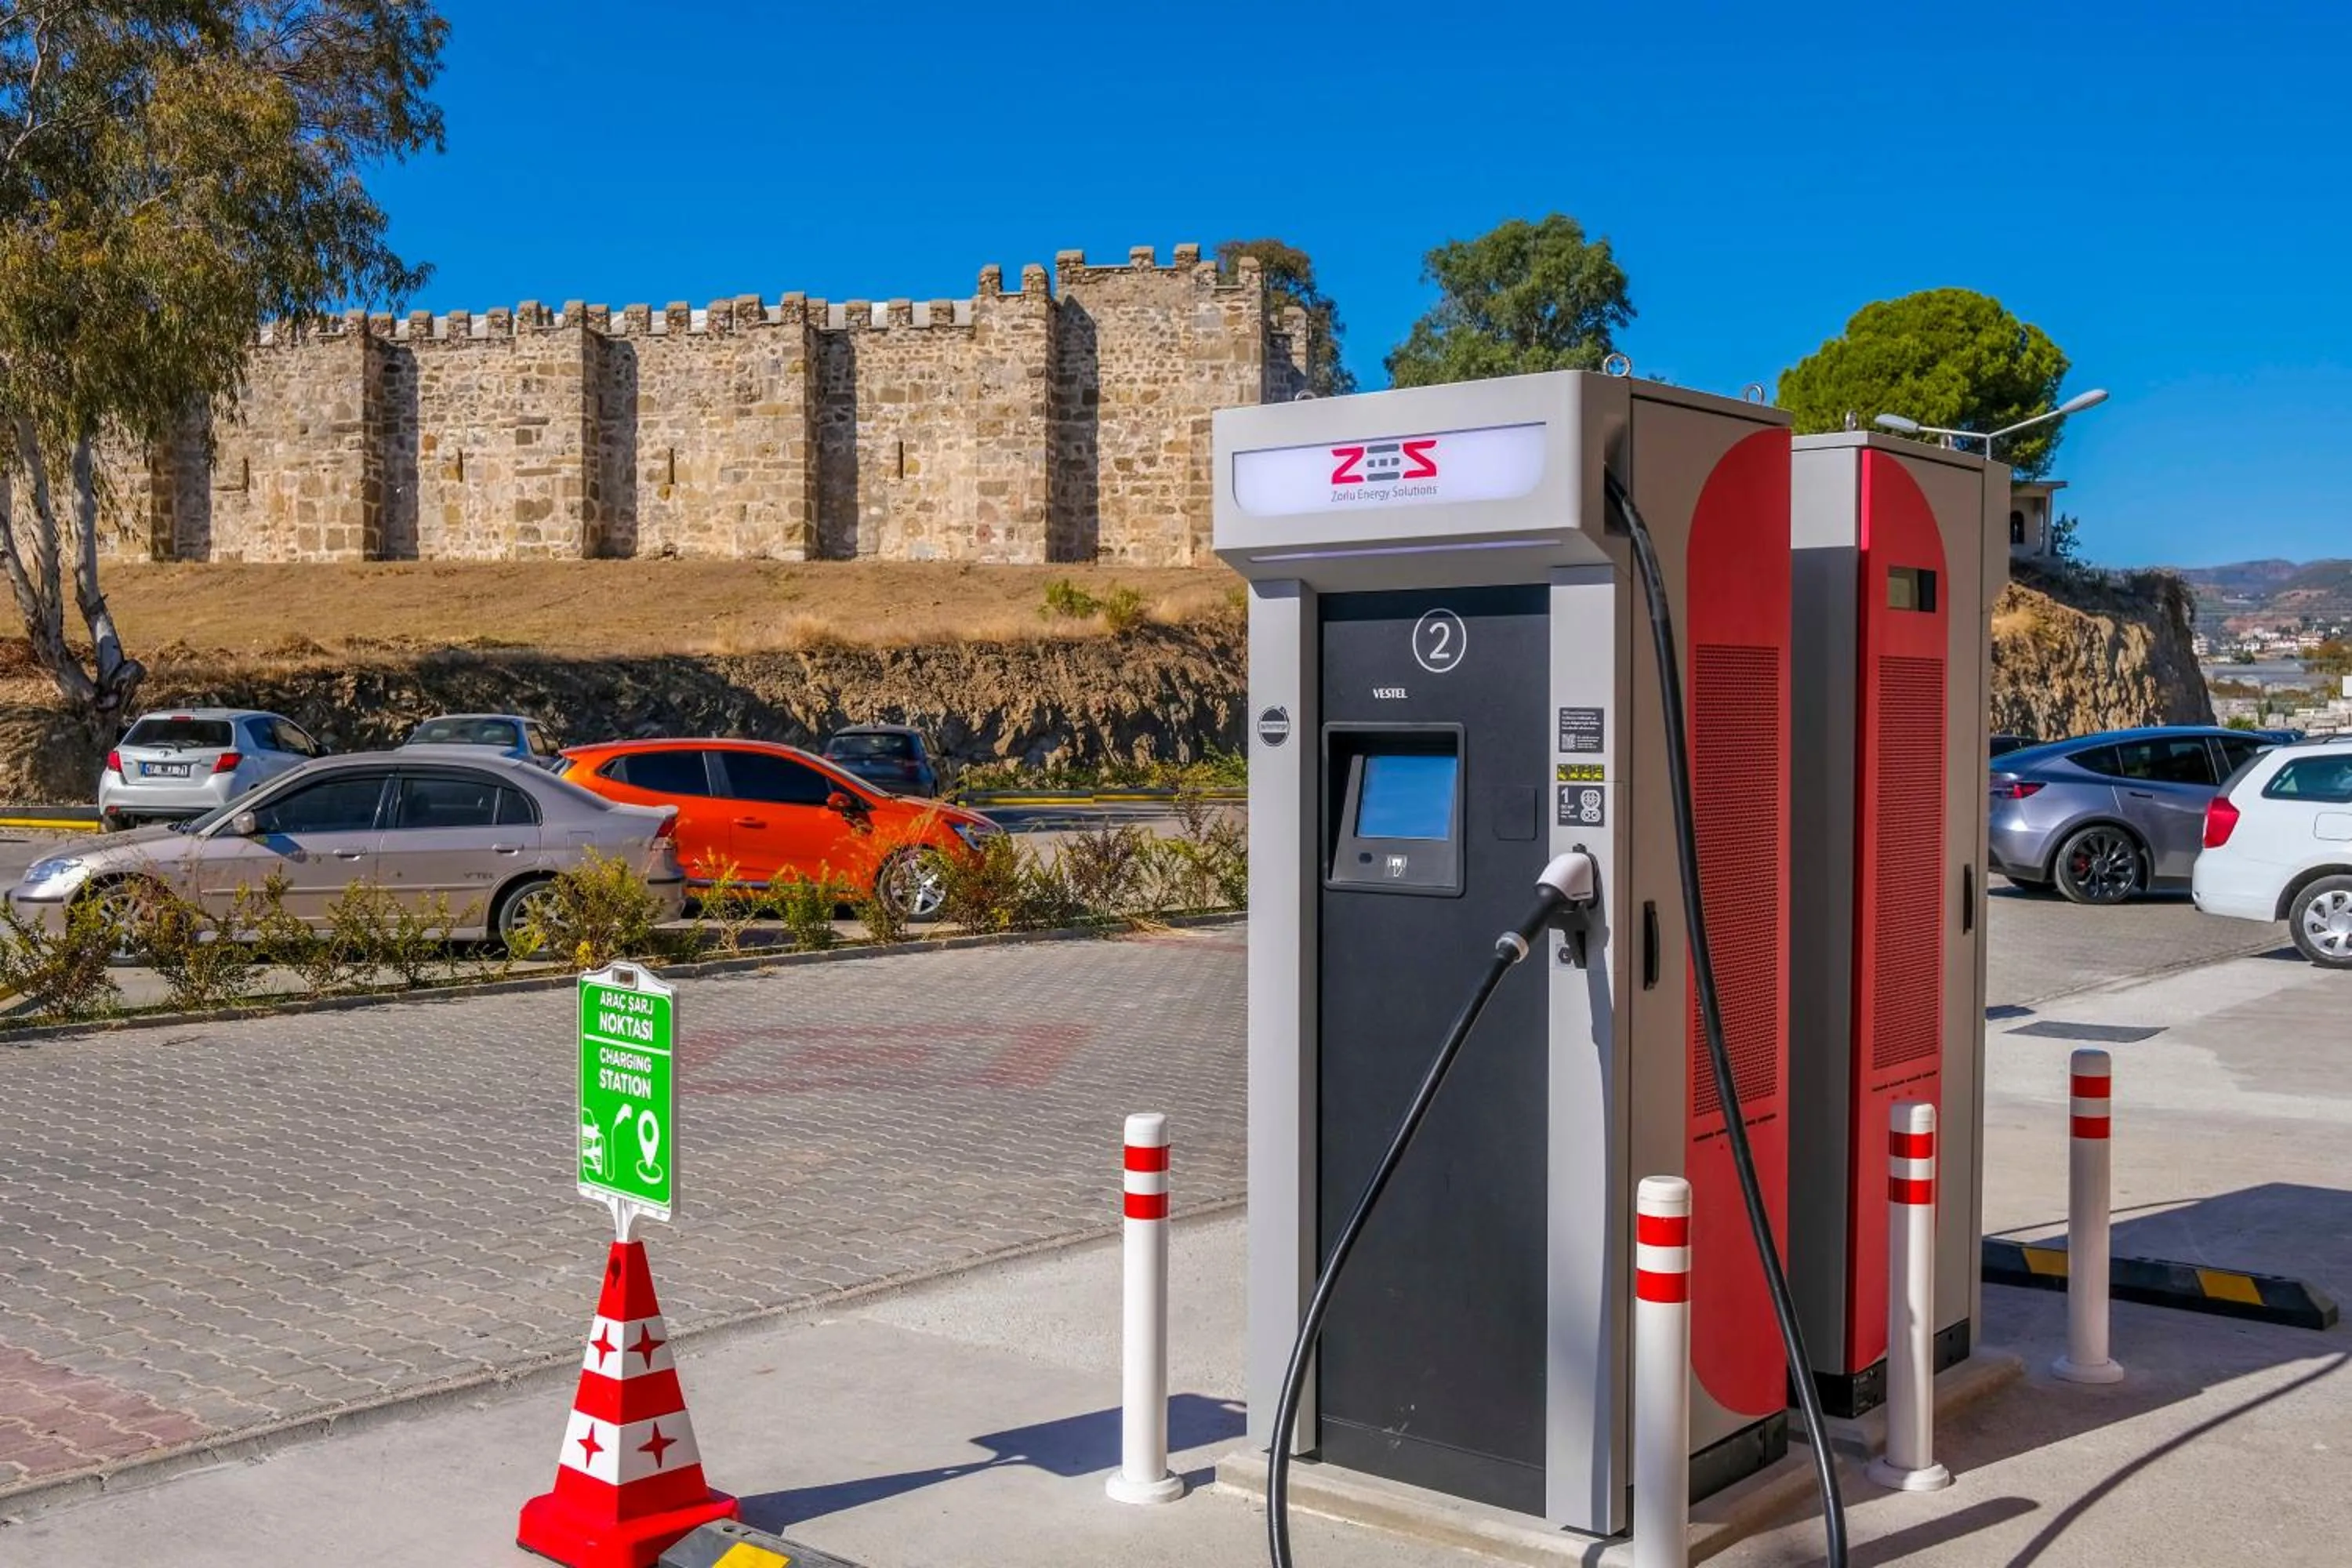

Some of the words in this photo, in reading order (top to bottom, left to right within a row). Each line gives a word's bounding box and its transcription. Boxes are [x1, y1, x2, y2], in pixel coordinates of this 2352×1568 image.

[1331, 440, 1437, 485] ZES
[1331, 490, 1356, 503] Zorlu
[1357, 488, 1390, 500] Energy
[1392, 485, 1438, 498] Solutions
[1429, 622, 1450, 659] 2
[1373, 688, 1409, 699] VESTEL
[1561, 787, 1569, 804] 1
[600, 990, 626, 1012] ARAÇ
[628, 996, 654, 1015] ŞARJ
[599, 1011, 653, 1042] NOKTASI
[599, 1047, 652, 1074] CHARGING
[598, 1067, 652, 1100] STATION
